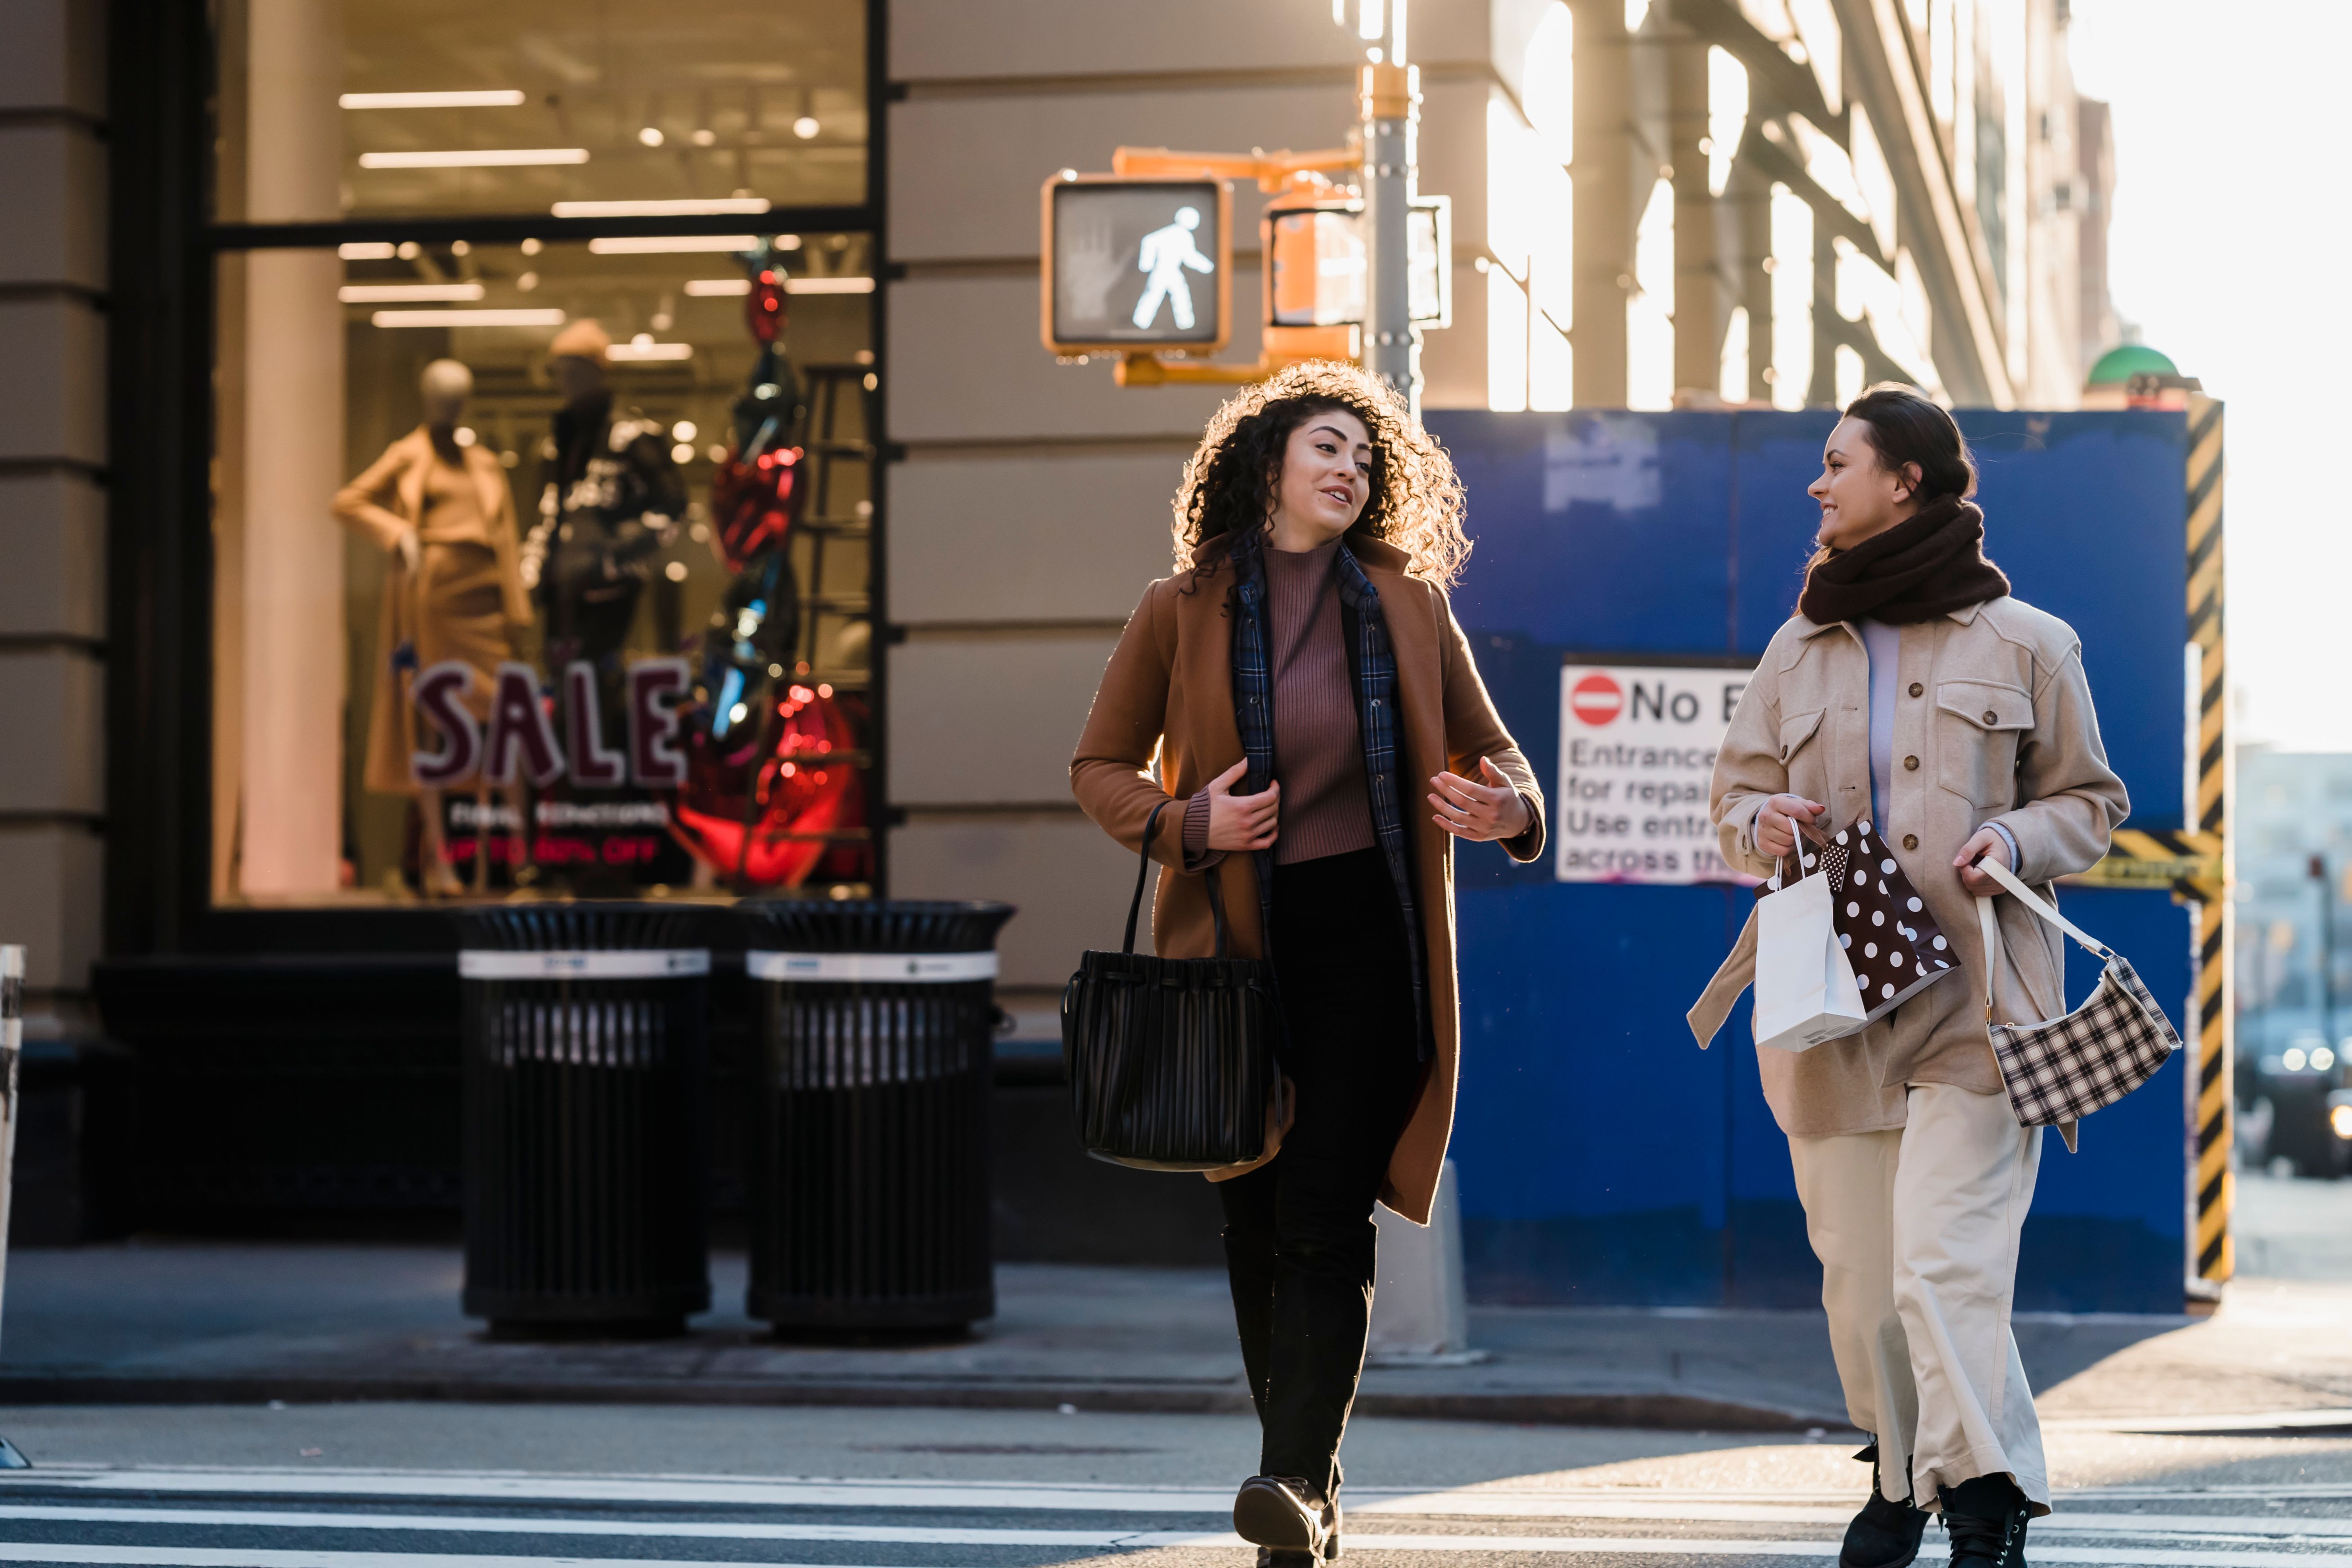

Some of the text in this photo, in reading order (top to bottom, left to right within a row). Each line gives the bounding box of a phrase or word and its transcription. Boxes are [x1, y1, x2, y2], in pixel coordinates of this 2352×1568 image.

[1632, 682, 1699, 723] No
[411, 656, 690, 788] SALE
[1570, 739, 1716, 767] Entrance
[1568, 776, 1611, 800] for
[1569, 809, 1630, 836] Use
[1567, 849, 1679, 872] across
